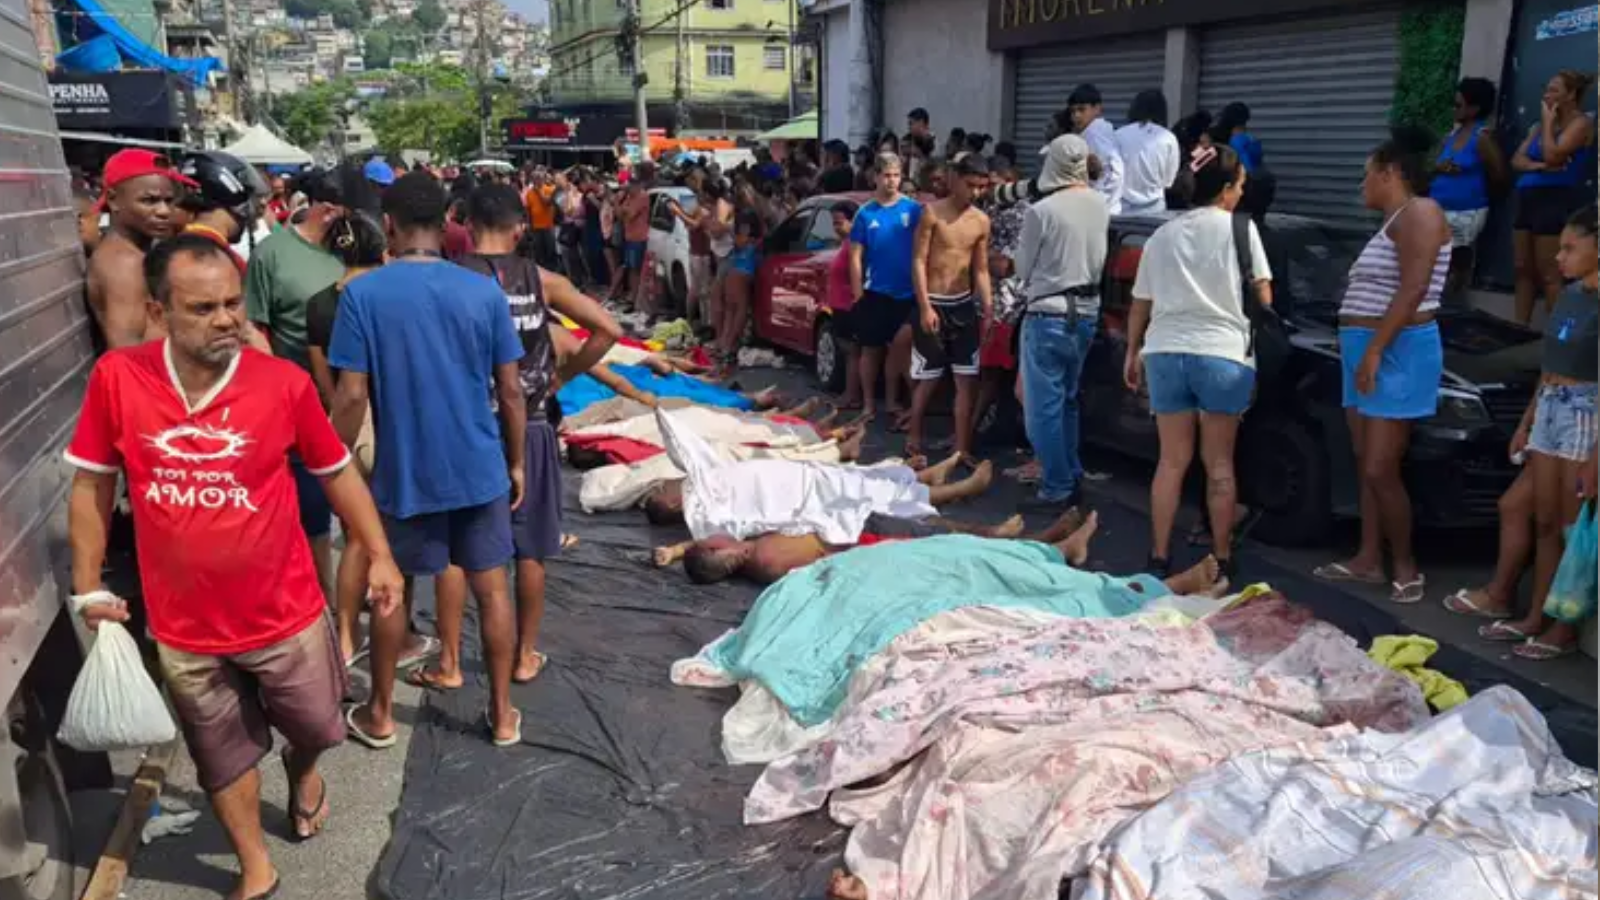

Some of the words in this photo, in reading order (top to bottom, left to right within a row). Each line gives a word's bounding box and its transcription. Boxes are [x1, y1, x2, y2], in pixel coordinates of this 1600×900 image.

[49, 83, 109, 98] PENHA
[192, 469, 240, 486] POR
[145, 481, 259, 511] AMOR
